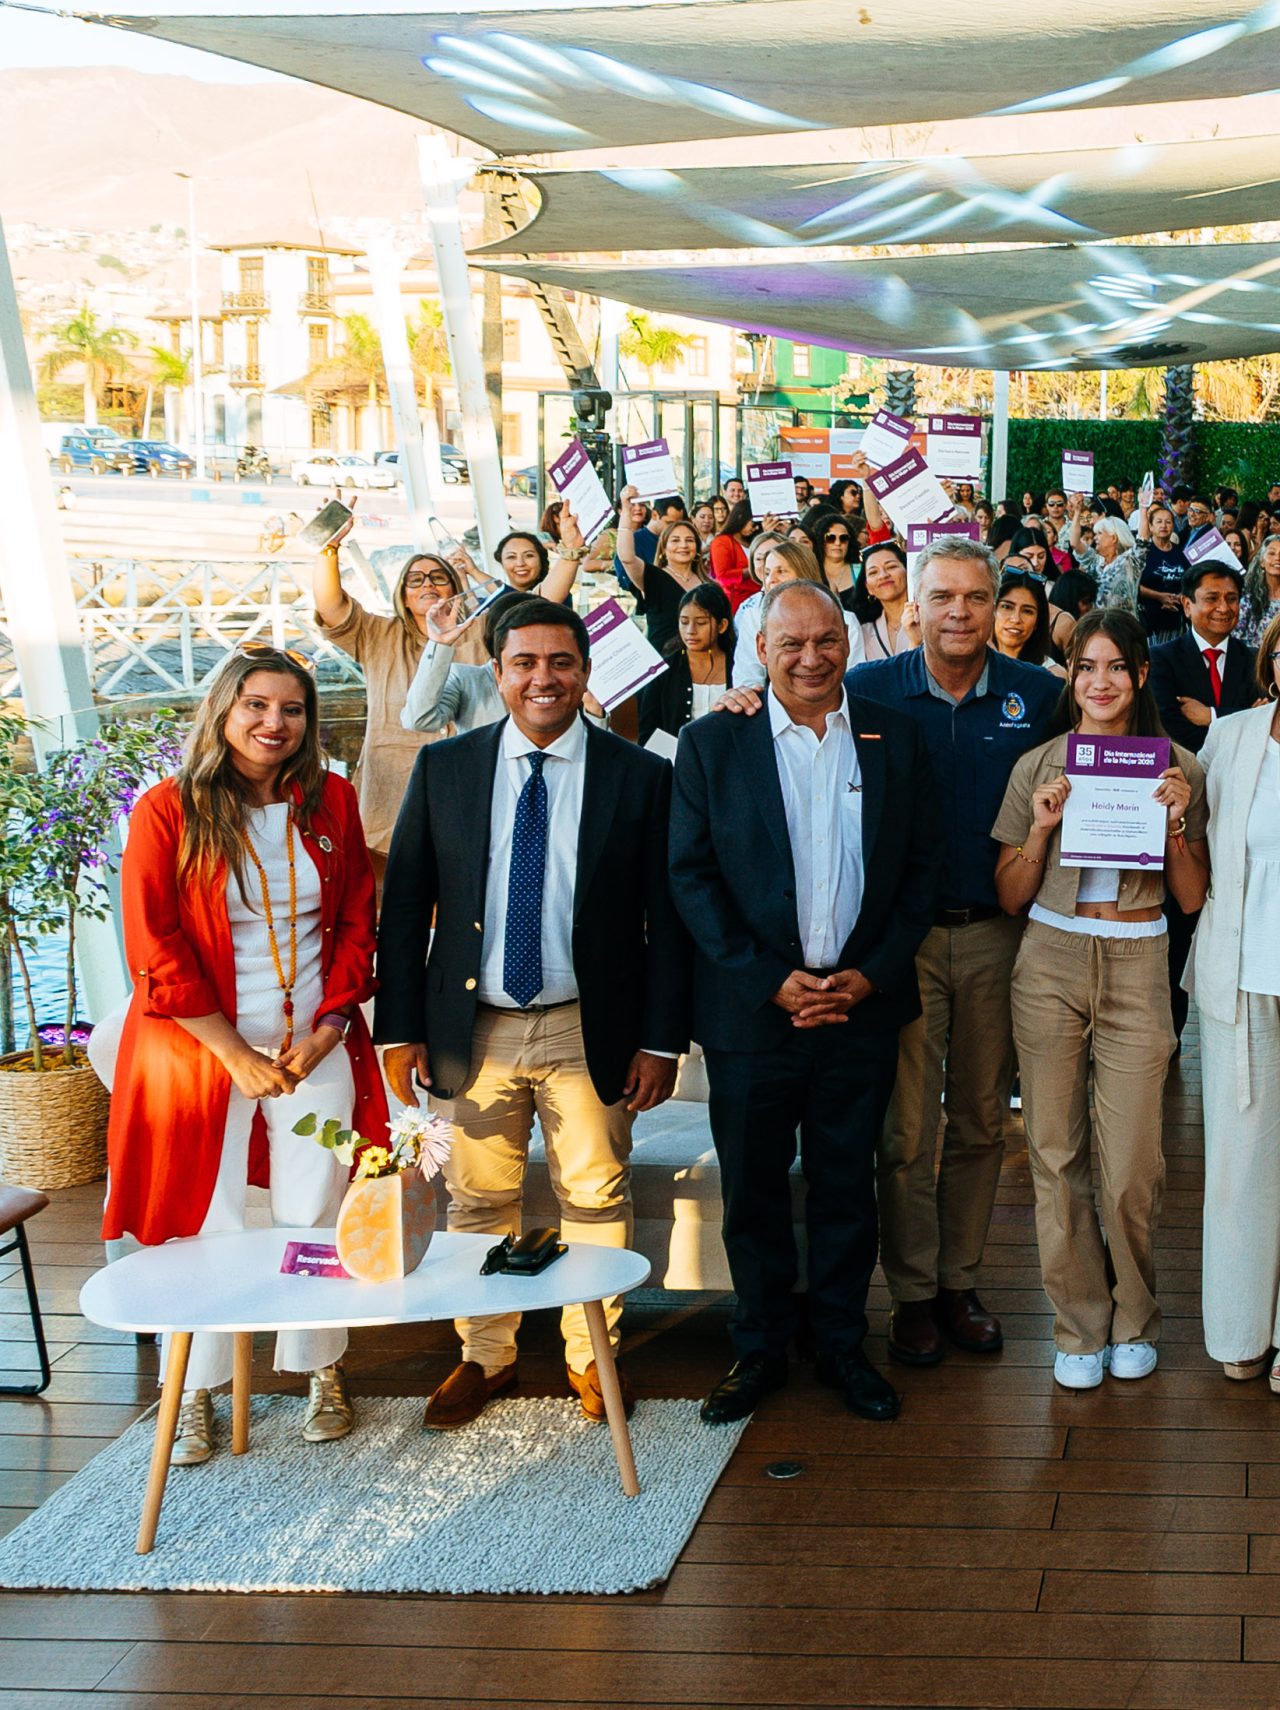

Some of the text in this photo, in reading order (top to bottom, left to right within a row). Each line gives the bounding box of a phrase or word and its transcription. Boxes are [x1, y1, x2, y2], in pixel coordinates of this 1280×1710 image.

[1078, 747, 1093, 756] 35
[1115, 750, 1156, 758] Internacional
[1119, 757, 1137, 765] Mujer
[1091, 802, 1115, 811] Heidy
[296, 1254, 340, 1266] Reservado
